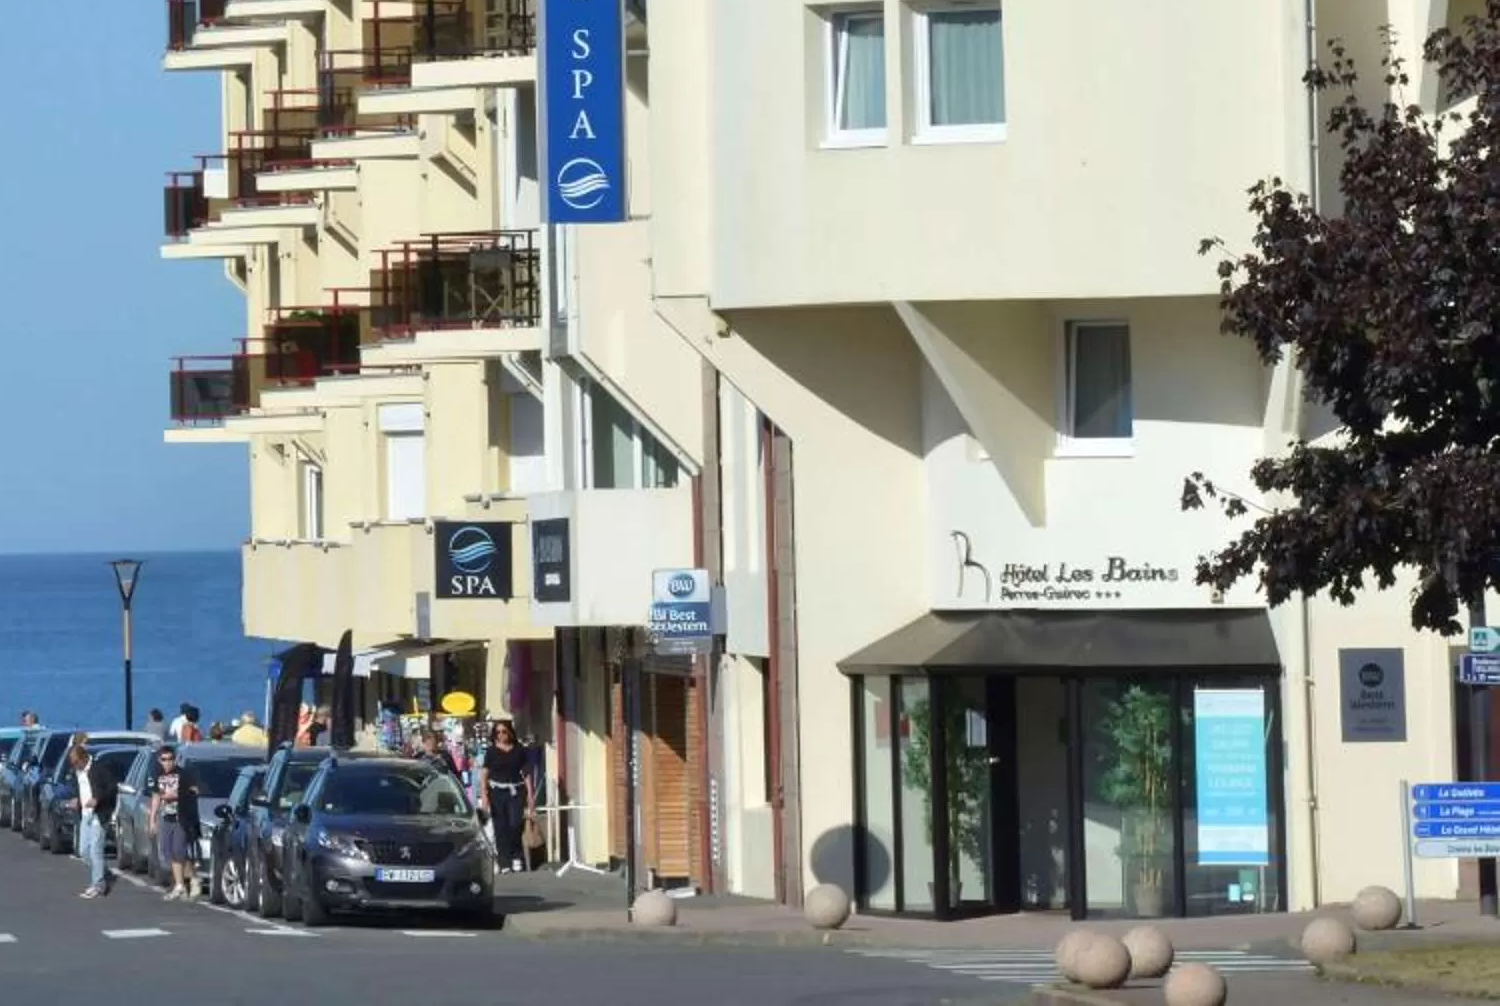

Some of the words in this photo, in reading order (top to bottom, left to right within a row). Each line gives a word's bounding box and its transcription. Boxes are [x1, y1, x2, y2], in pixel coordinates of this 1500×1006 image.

[570, 29, 597, 139] SPA
[1056, 562, 1094, 583] Les
[1101, 557, 1179, 582] Bains
[451, 575, 497, 595] SPA
[669, 609, 697, 621] Best
